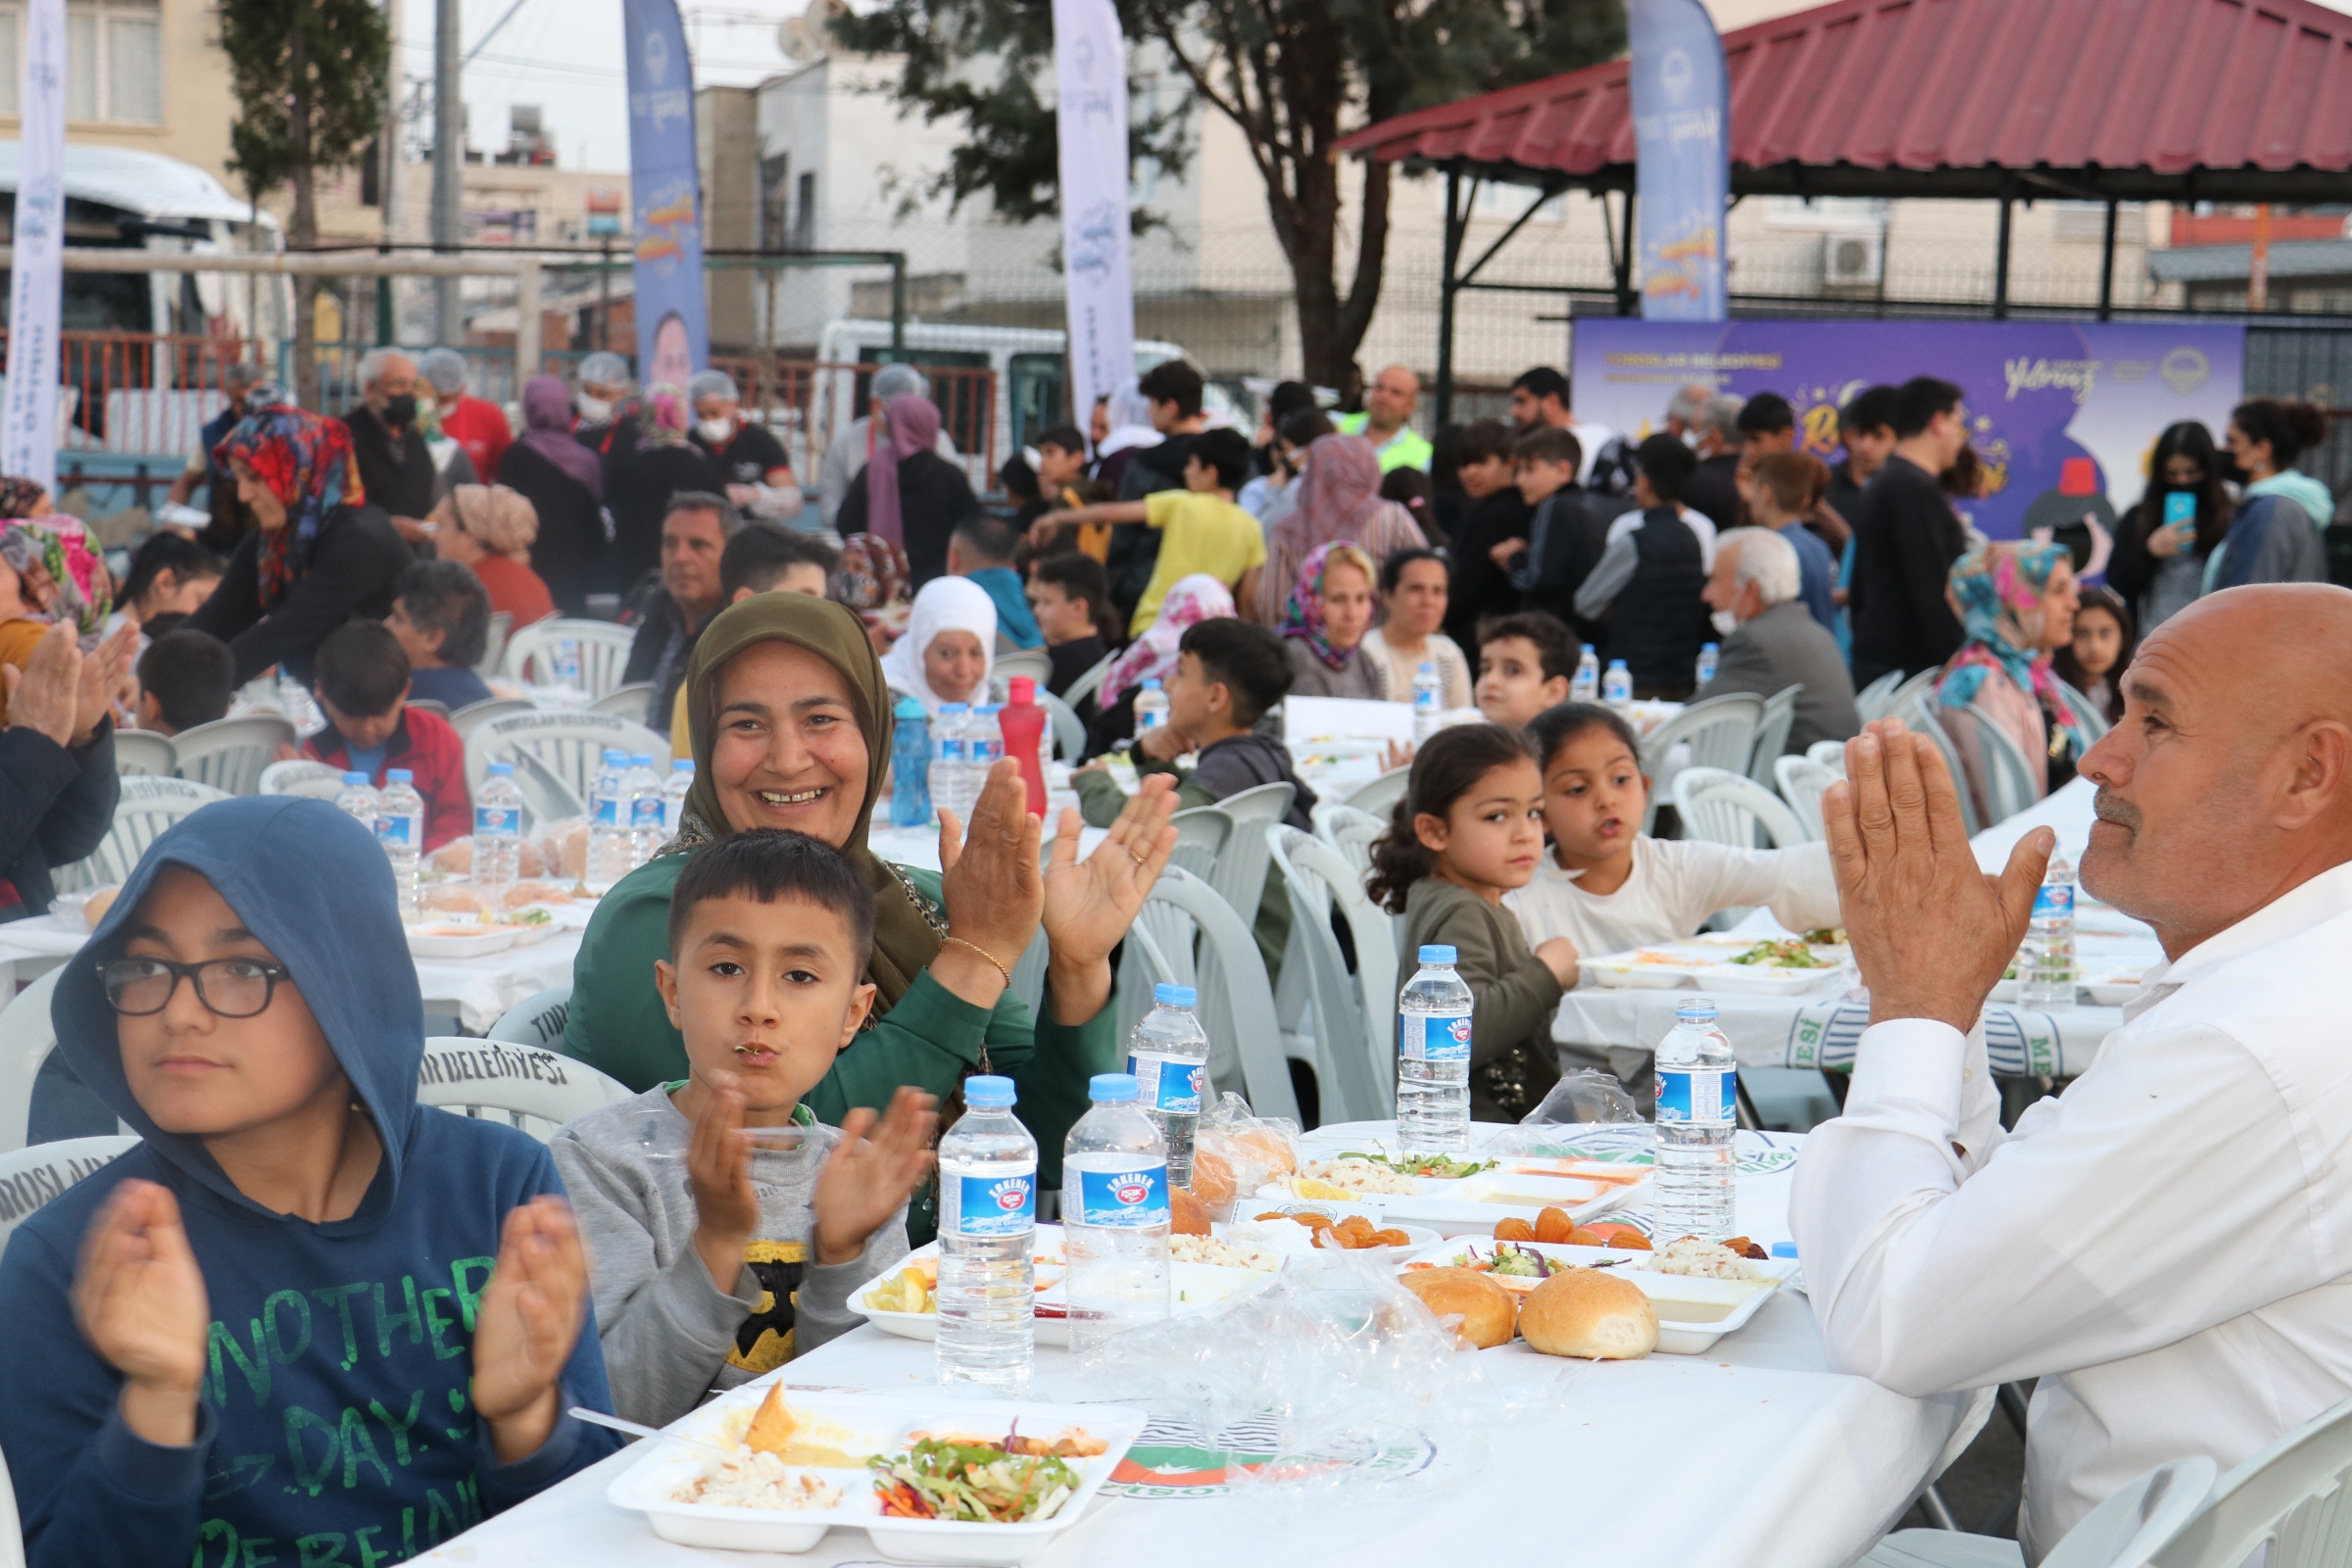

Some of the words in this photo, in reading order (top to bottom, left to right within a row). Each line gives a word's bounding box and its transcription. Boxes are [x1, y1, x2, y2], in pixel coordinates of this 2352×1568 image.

[530, 1001, 569, 1043] TOR
[989, 1179, 1031, 1198] ERKENEK
[1106, 1173, 1155, 1192] ERKENEK
[202, 1256, 496, 1409] NOTHER
